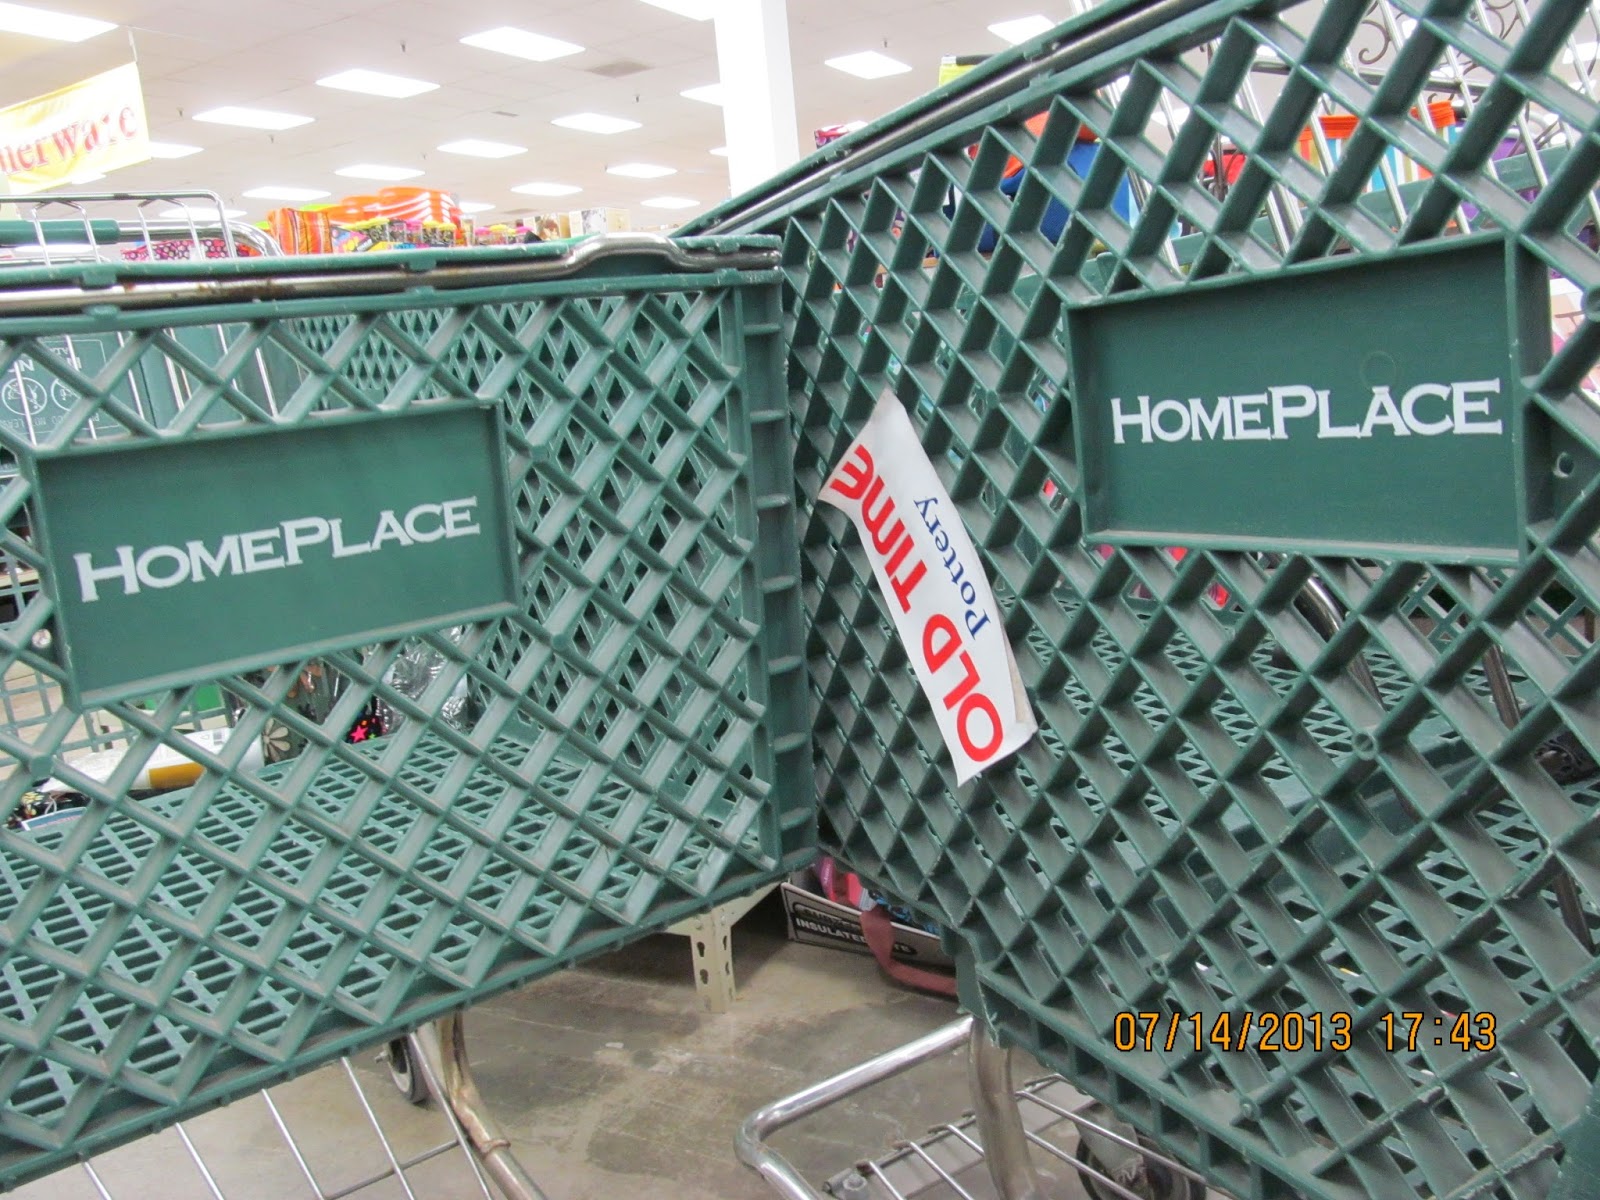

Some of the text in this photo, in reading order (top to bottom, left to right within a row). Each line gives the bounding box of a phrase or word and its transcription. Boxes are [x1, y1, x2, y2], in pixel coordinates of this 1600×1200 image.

[829, 444, 1004, 763] OLD TIME
[914, 495, 990, 640] Pottery
